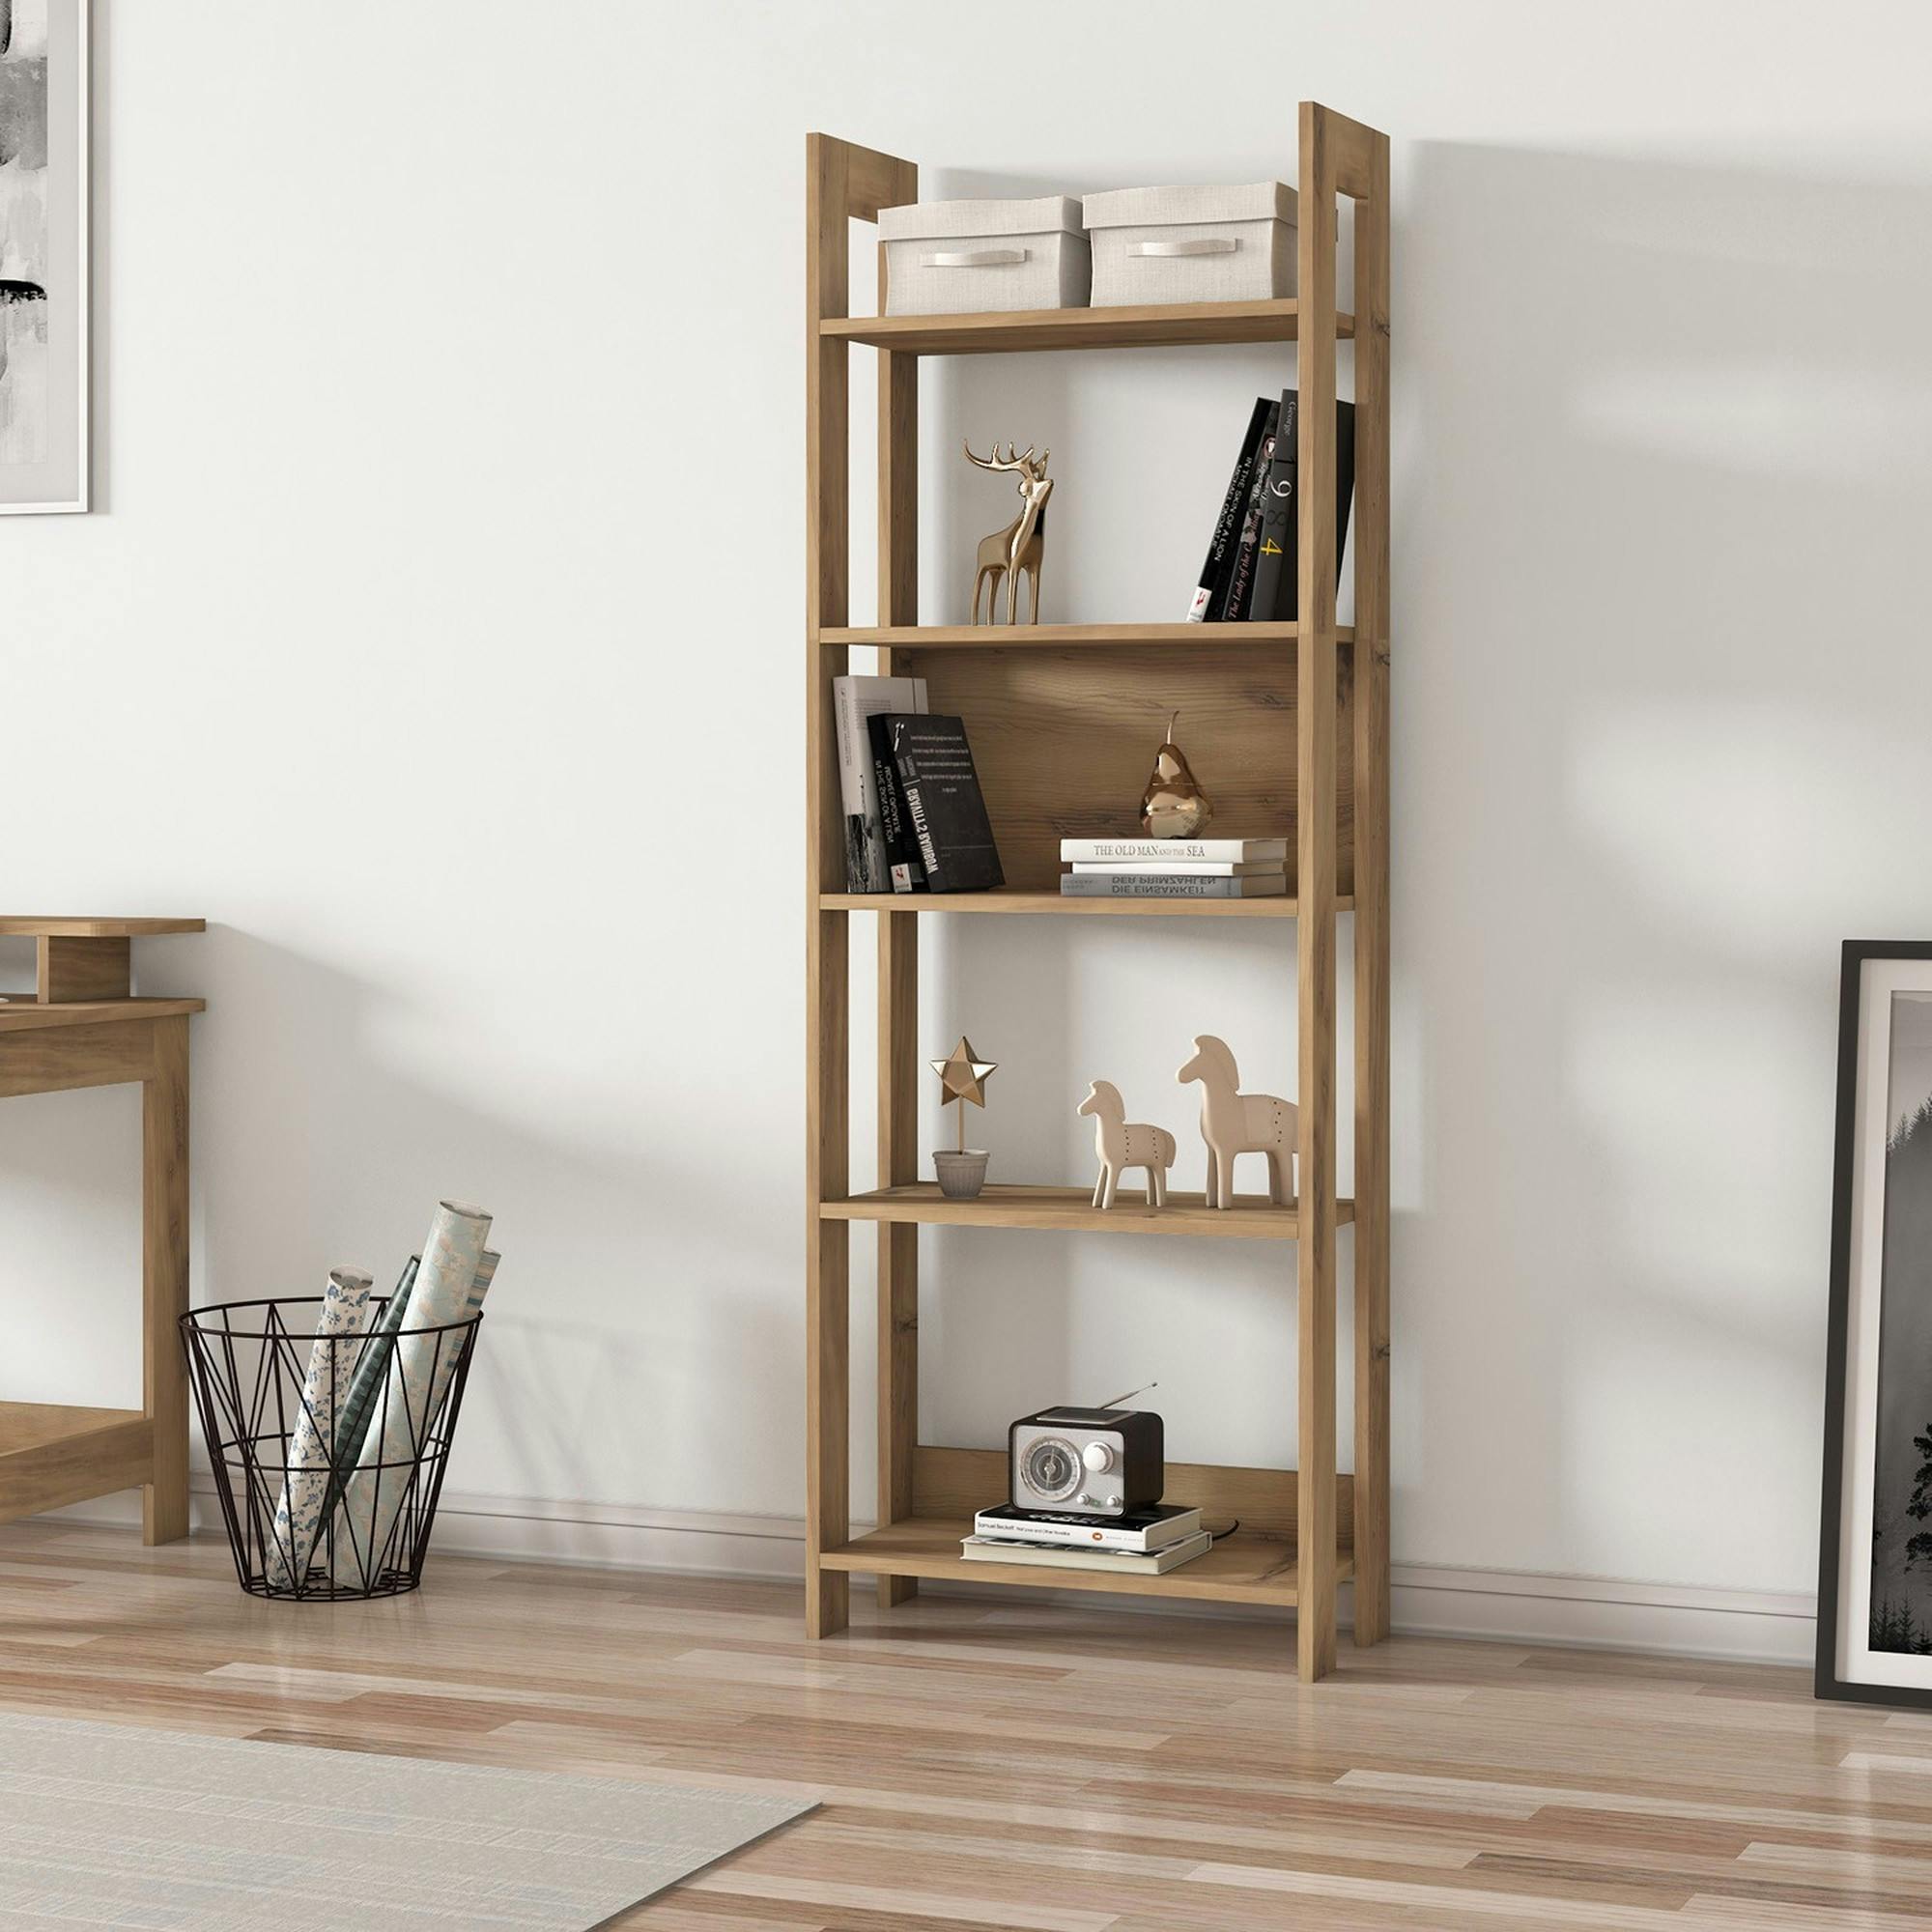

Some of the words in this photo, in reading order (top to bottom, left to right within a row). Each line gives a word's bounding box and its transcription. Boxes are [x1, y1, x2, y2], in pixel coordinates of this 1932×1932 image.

[1244, 456, 1253, 468] IN
[1237, 469, 1249, 489] THE
[1230, 490, 1242, 513] SKIN
[1226, 514, 1235, 528] OF
[1214, 538, 1227, 561] LION
[1240, 553, 1251, 567] the
[1239, 565, 1249, 579] of
[1233, 579, 1246, 601] Lady
[1229, 603, 1240, 618] The
[1094, 845, 1112, 856] THE
[1115, 845, 1136, 856] OLD
[1137, 845, 1158, 857] MAN
[1186, 845, 1206, 857] SEA
